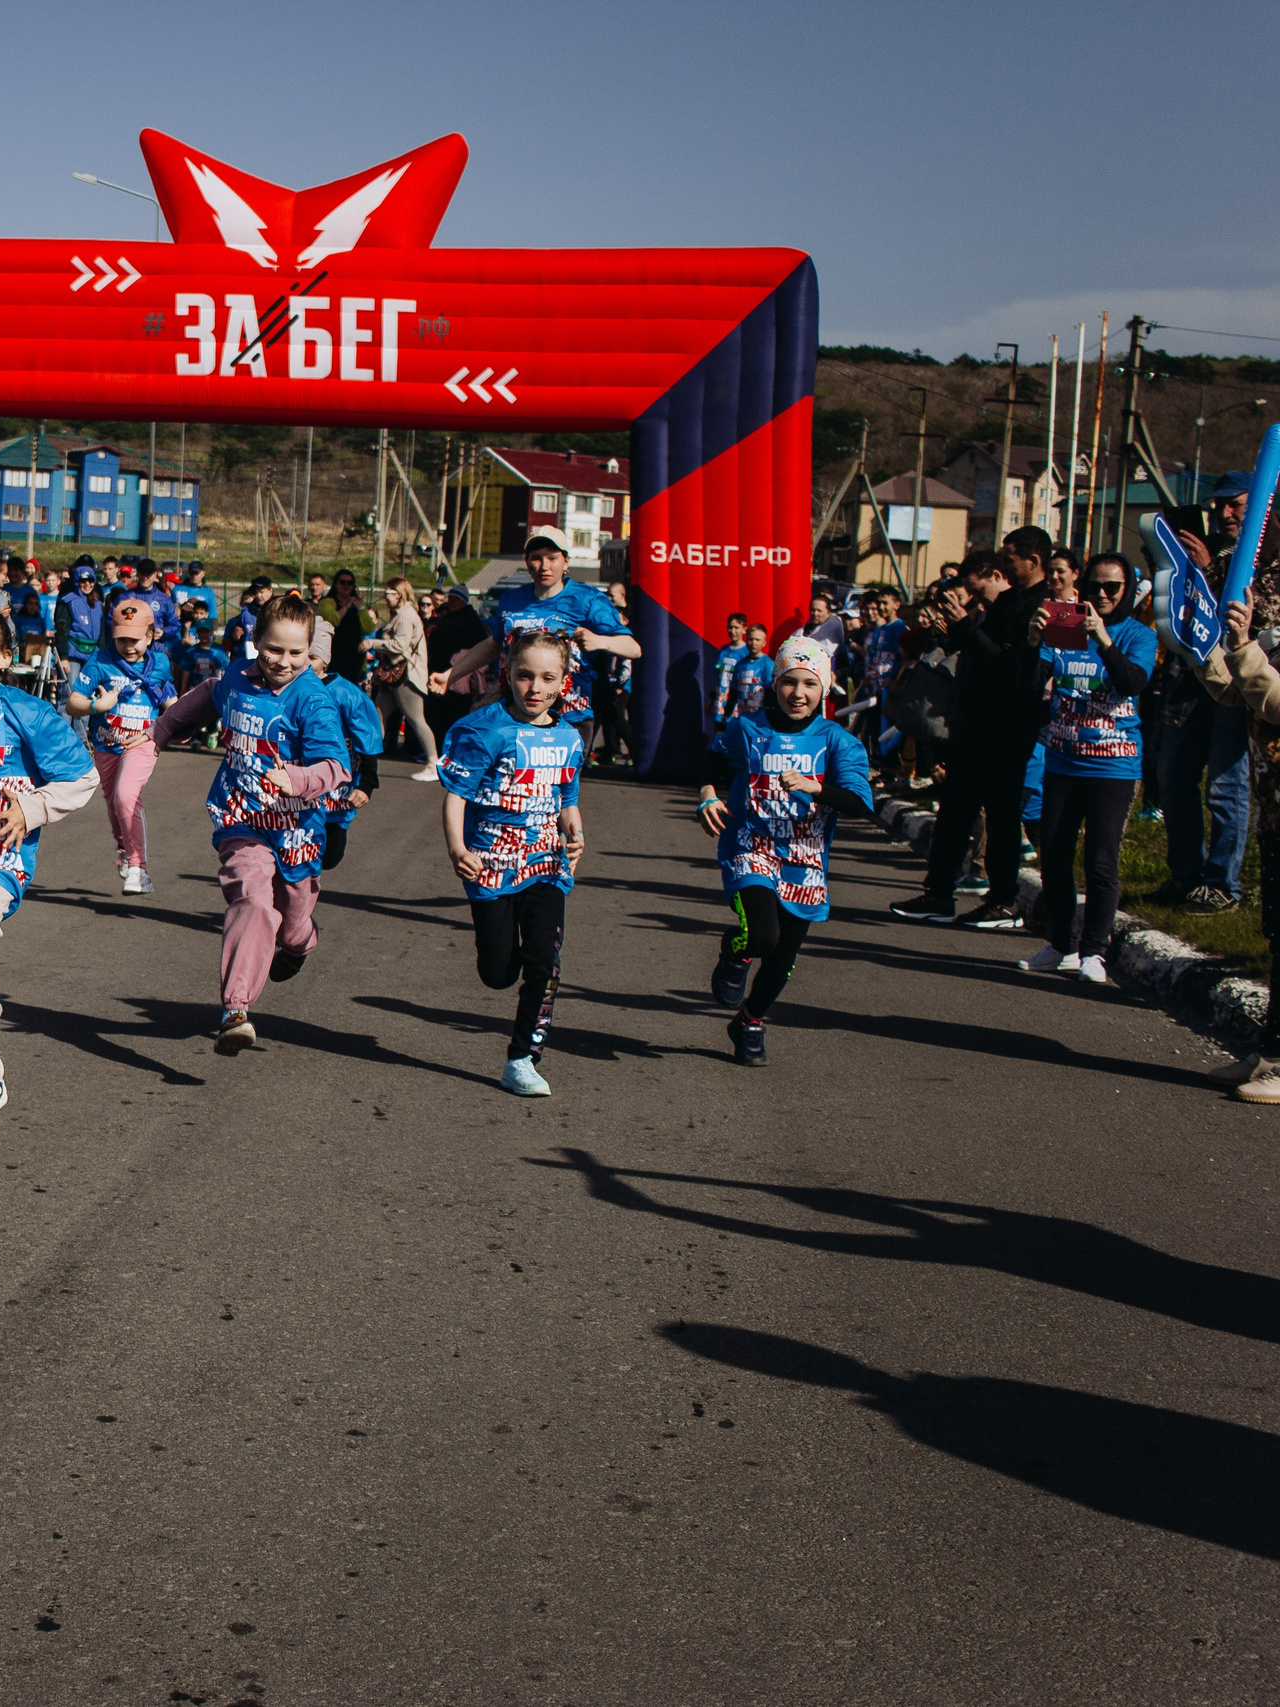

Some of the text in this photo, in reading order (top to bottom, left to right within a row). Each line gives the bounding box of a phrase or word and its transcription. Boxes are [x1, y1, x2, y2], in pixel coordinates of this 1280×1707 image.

[650, 541, 791, 567] ЗАБЕГ.РФ
[1067, 661, 1098, 677] 10019
[230, 709, 265, 736] 00513
[530, 746, 568, 766] 00517
[763, 753, 812, 773] 00520
